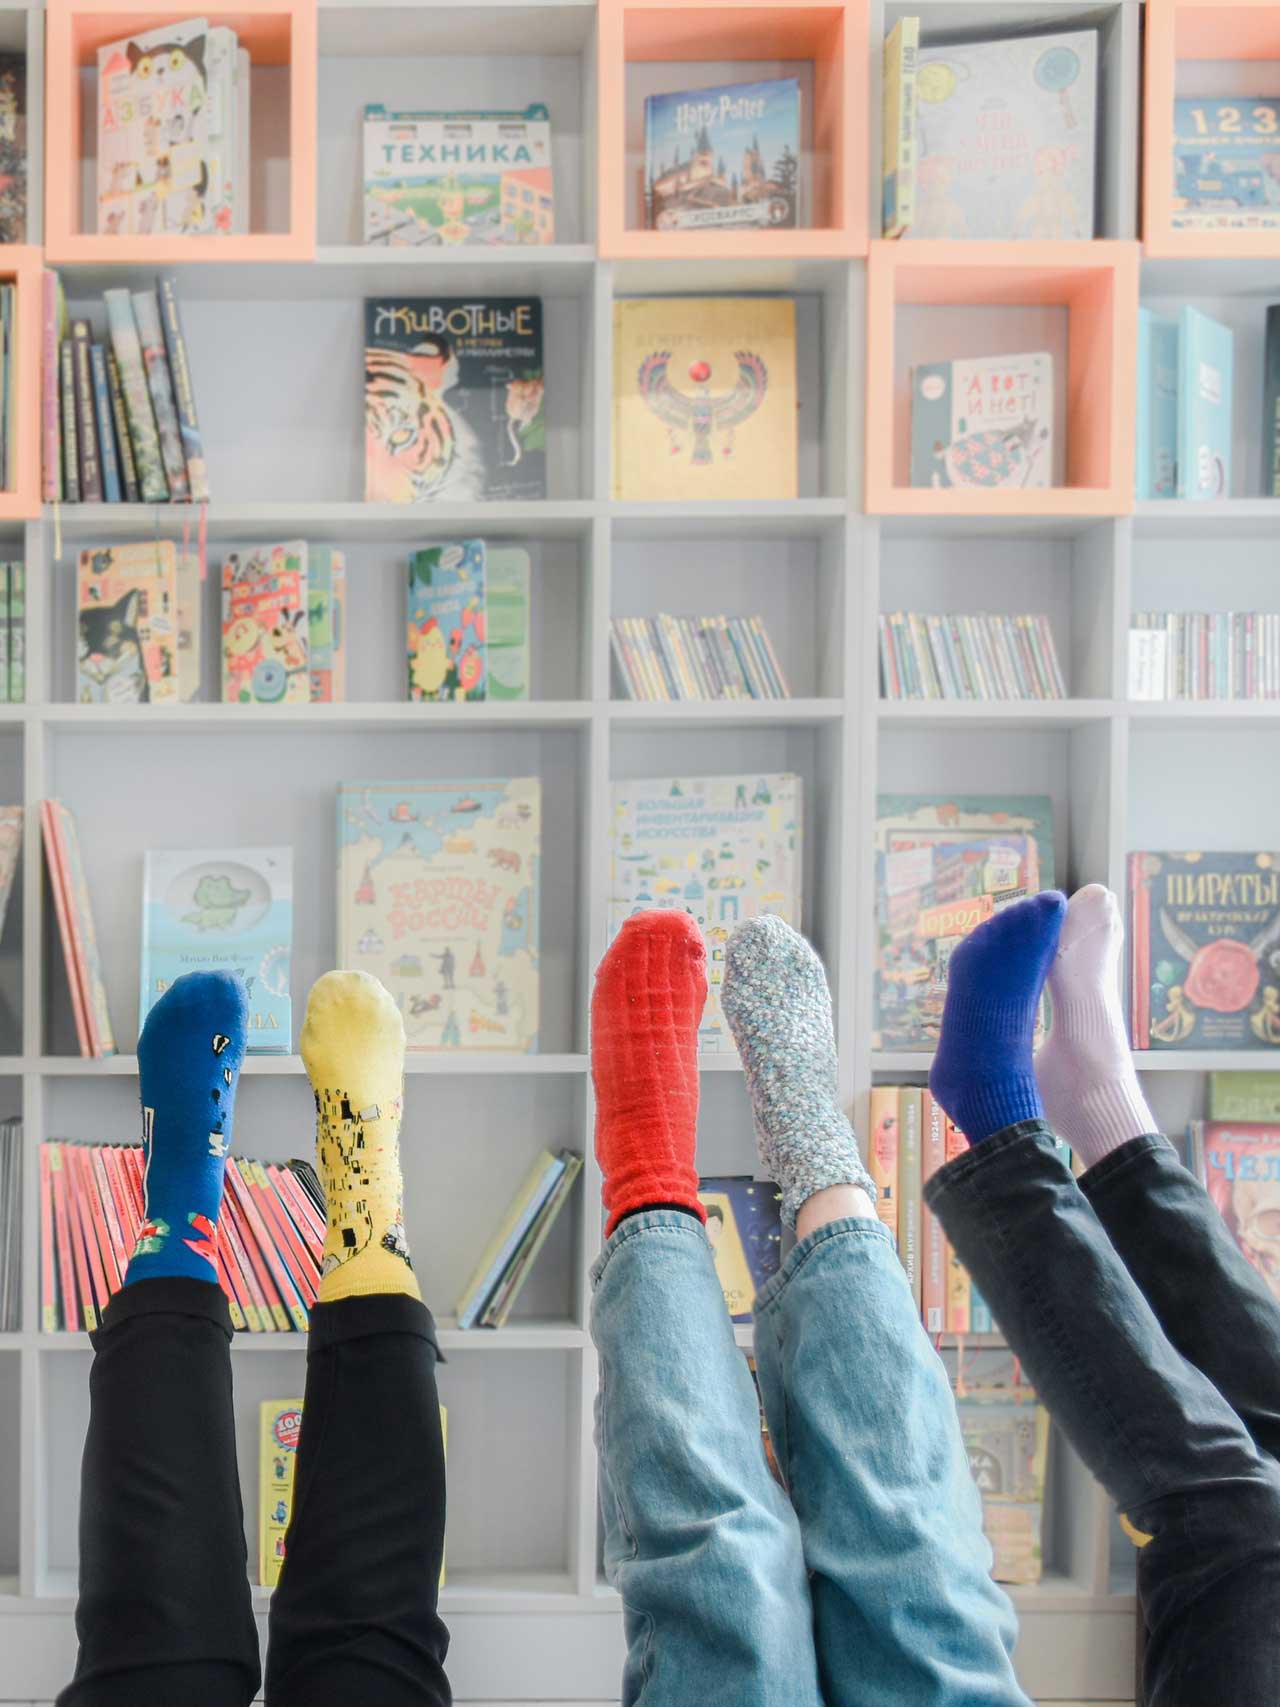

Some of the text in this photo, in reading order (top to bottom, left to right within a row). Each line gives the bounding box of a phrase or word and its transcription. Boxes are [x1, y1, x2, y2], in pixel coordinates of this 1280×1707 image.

[677, 95, 766, 133] Harry Potter
[381, 144, 533, 164] ТЕХНИКА
[1167, 873, 1278, 906] ПИРАТЫ
[931, 1098, 940, 1142] 1924-194
[1209, 1151, 1280, 1181] ЧЕЛ
